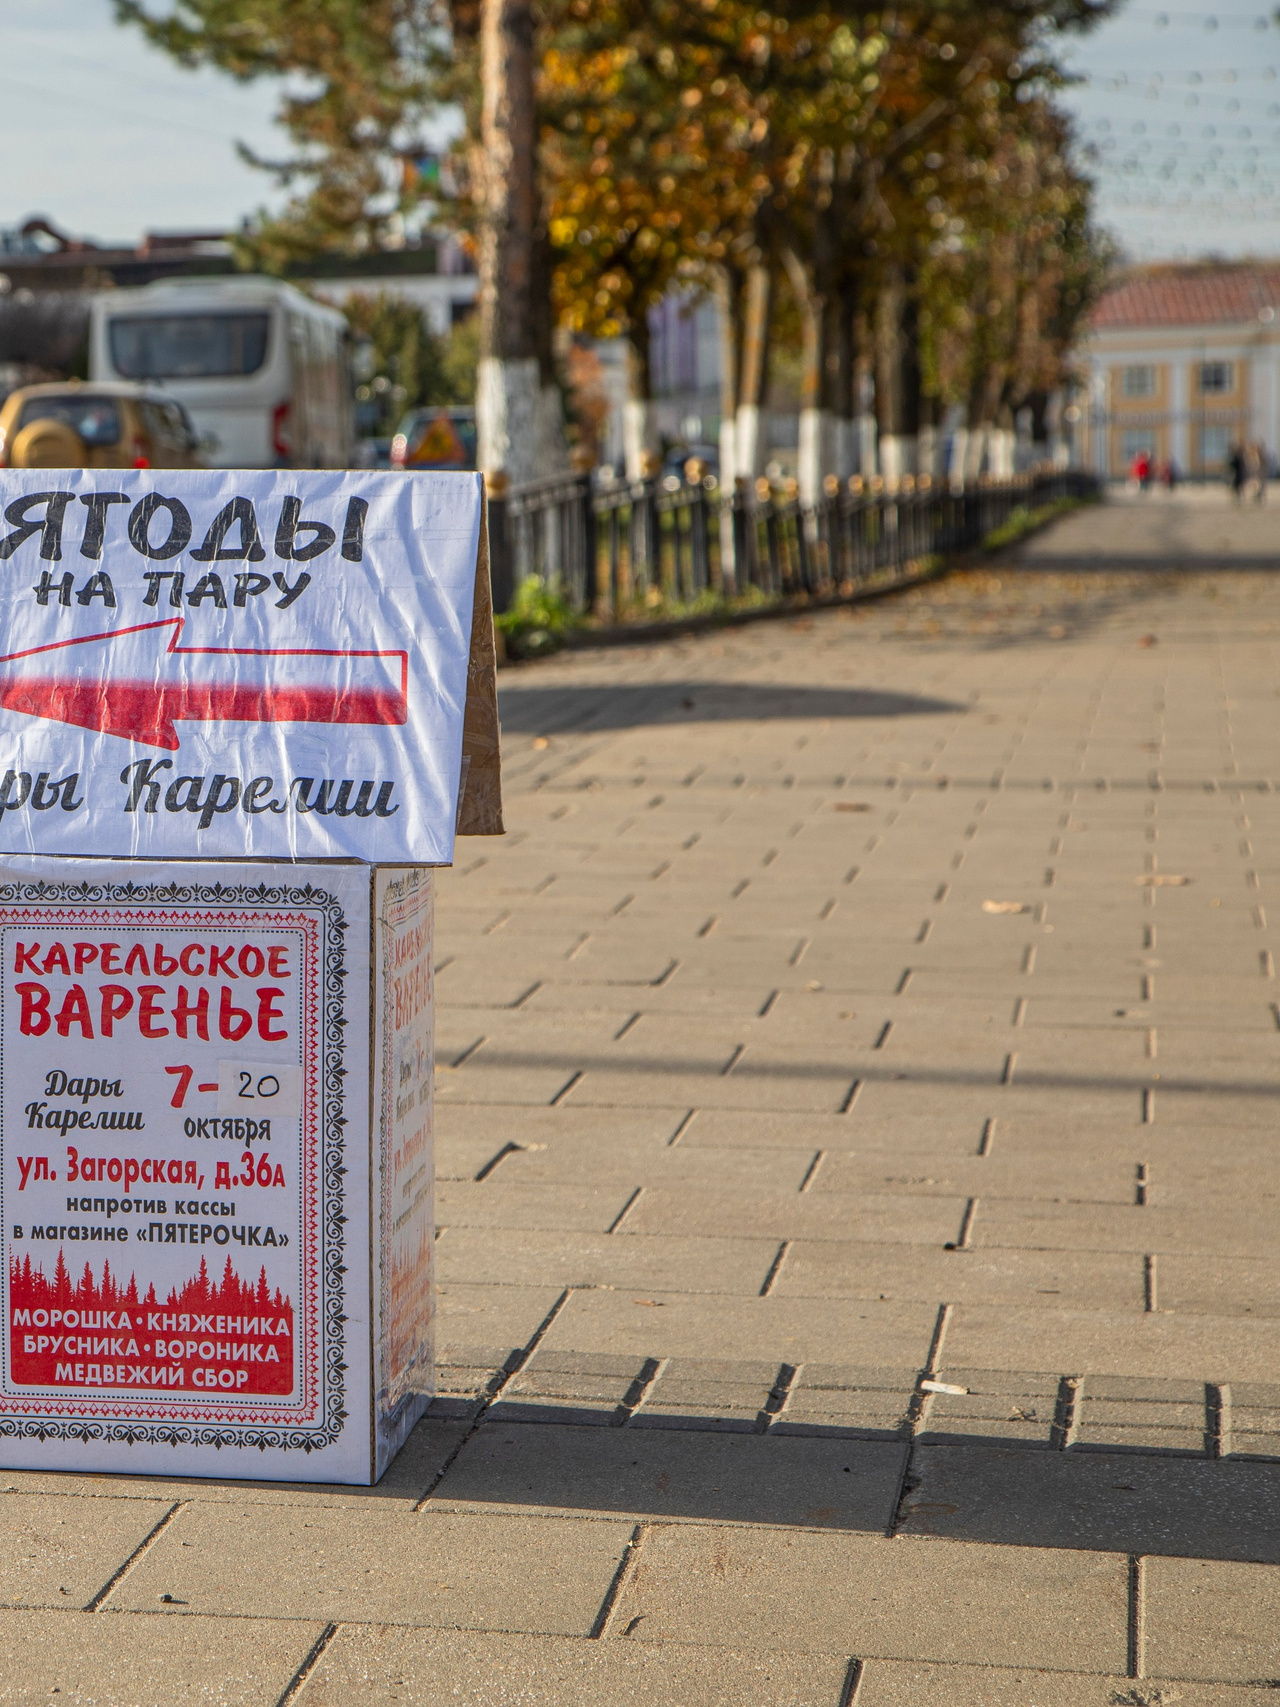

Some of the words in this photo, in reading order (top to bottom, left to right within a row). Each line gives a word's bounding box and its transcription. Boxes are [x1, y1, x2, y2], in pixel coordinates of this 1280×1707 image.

[33, 571, 115, 607] НА
[143, 572, 311, 609] ПАРУ
[120, 759, 399, 829] Карелии
[14, 942, 290, 978] КАРЕЛЬСКОЕ
[15, 982, 288, 1041] ВАРЕНЬЕ
[45, 1070, 124, 1102] Дары
[239, 1072, 279, 1098] 20
[25, 1102, 145, 1136] Карелии
[184, 1117, 270, 1148] октября
[17, 1157, 56, 1190] ул.
[67, 1146, 204, 1192] Загорская,
[67, 1198, 167, 1218] напротив
[176, 1201, 235, 1216] кассы
[14, 1226, 23, 1238] в
[31, 1226, 128, 1241] магазине
[137, 1223, 289, 1246] «ПЯТЕРОЧКА»
[12, 1309, 132, 1330] МОРОШКА
[148, 1313, 290, 1335] КНЯЖЕНИКА
[25, 1335, 139, 1356] БРУСНИКА
[156, 1339, 280, 1362] ВОРОНИКА
[55, 1362, 184, 1386] МЕДВЕЖИЙ
[192, 1367, 248, 1388] СБОР
